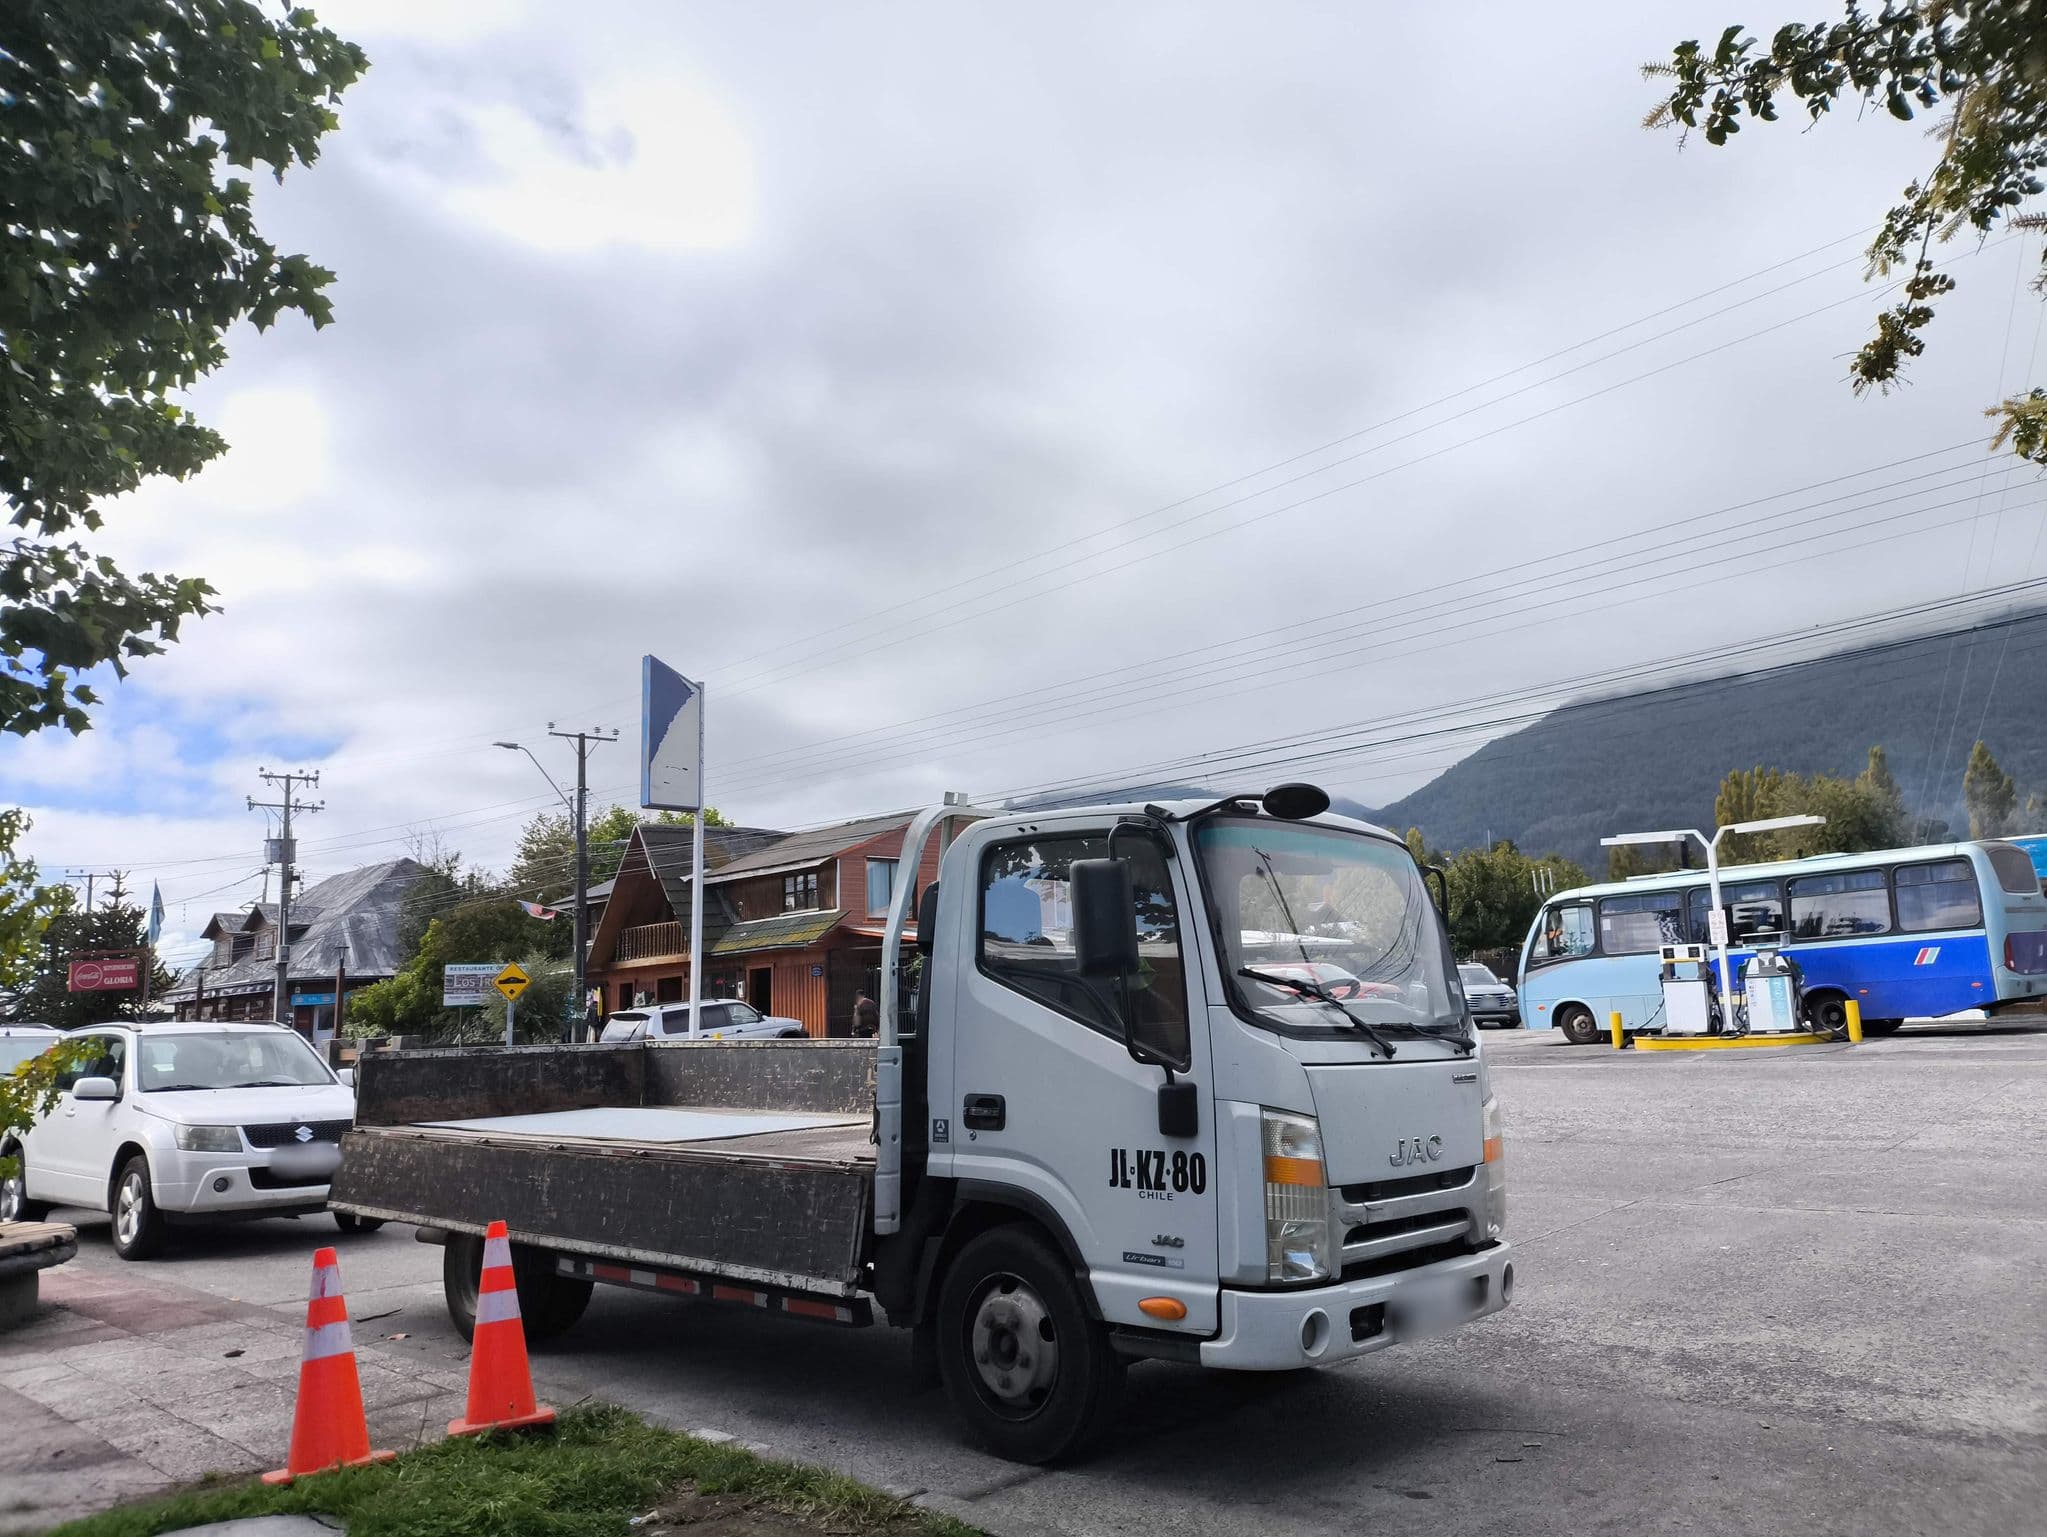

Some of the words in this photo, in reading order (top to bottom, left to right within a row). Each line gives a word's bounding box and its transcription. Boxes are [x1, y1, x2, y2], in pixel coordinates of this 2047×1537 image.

[103, 976, 134, 985] GLORIA
[1389, 1134, 1444, 1167] JAC
[1138, 1190, 1174, 1201] CHILE
[1151, 1234, 1185, 1248] JAC
[1125, 1254, 1161, 1265] Urban
